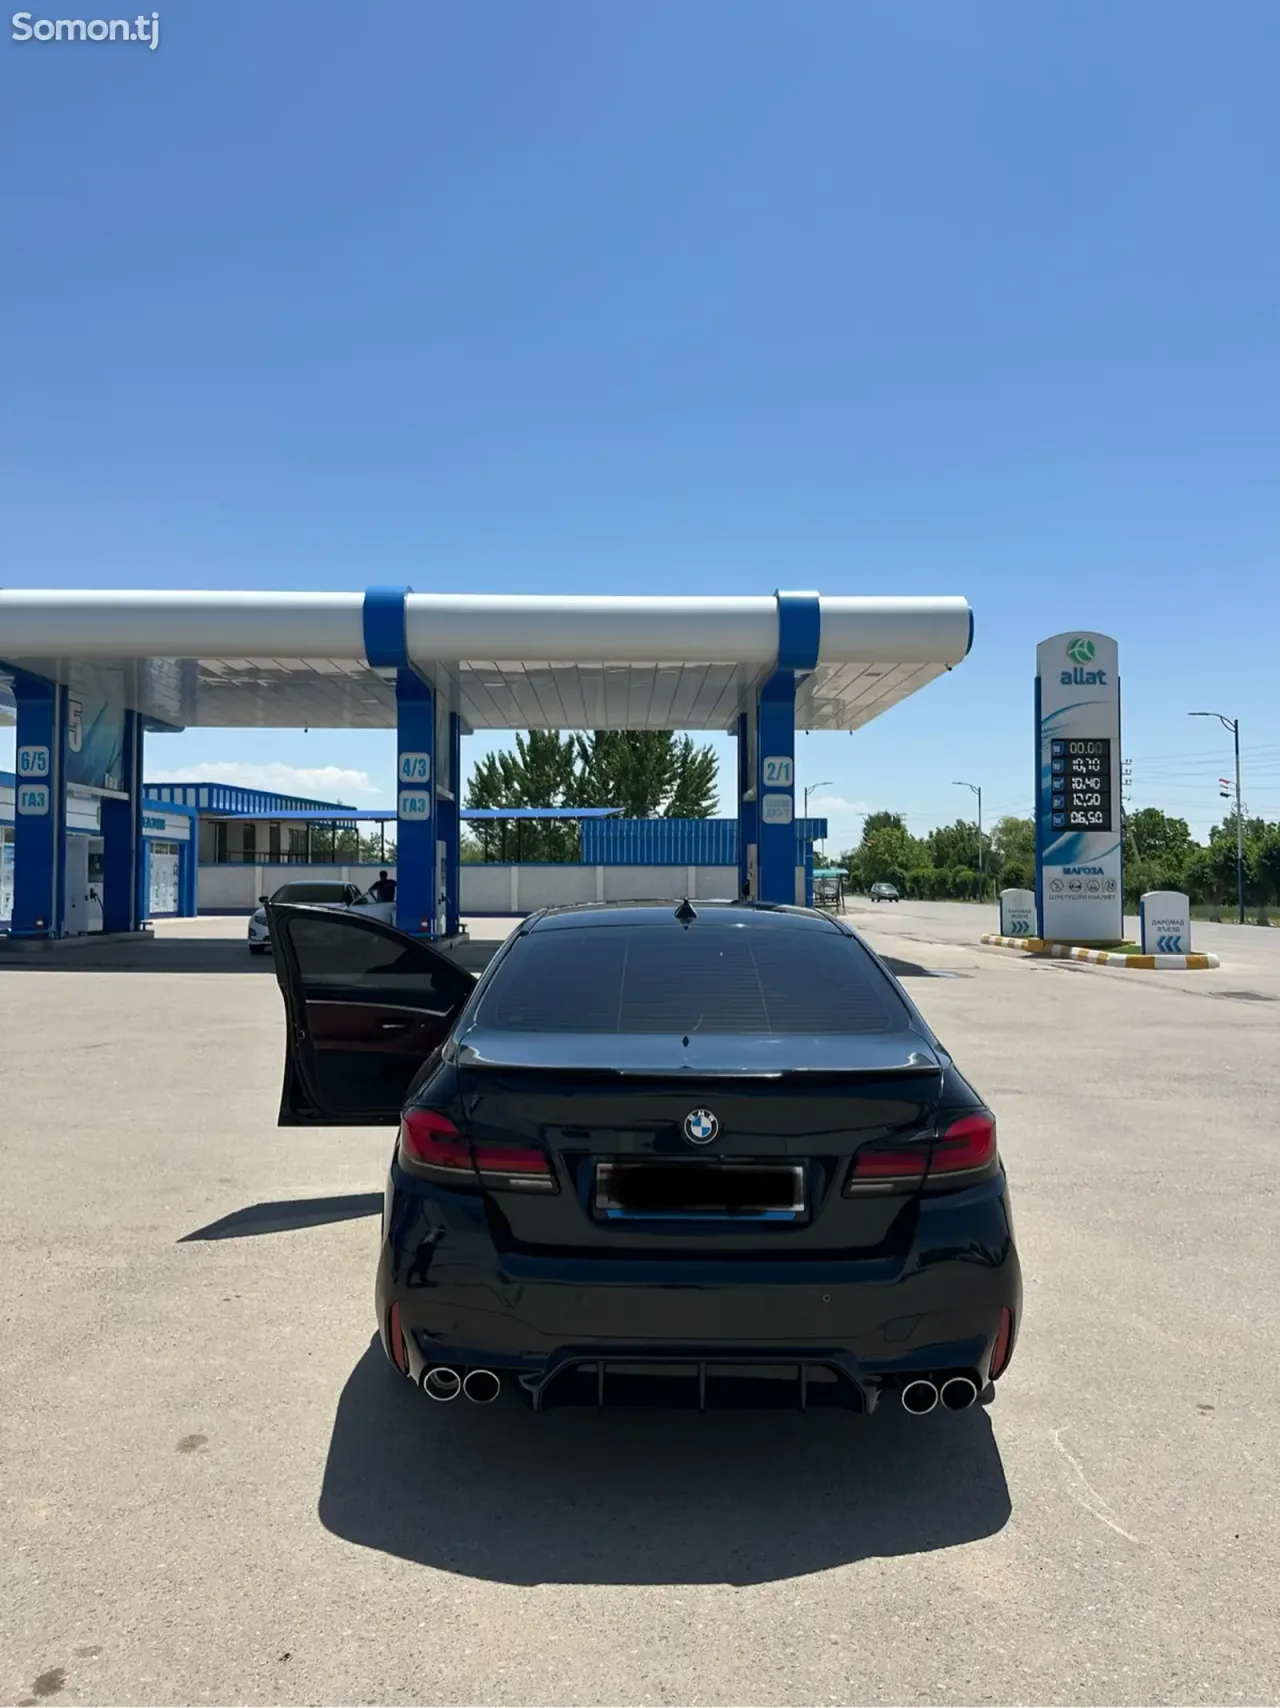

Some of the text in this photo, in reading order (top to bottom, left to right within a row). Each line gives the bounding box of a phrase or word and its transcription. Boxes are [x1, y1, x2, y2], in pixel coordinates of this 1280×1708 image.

[1060, 667, 1107, 685] allat
[21, 751, 46, 771] 6/5
[402, 758, 427, 777] 4/3
[767, 762, 790, 781] 2/1
[22, 792, 45, 807] ГАЗ
[403, 798, 426, 812] ГАЗ
[1063, 867, 1104, 875] МАГОЗА
[687, 1110, 715, 1122] BMW
